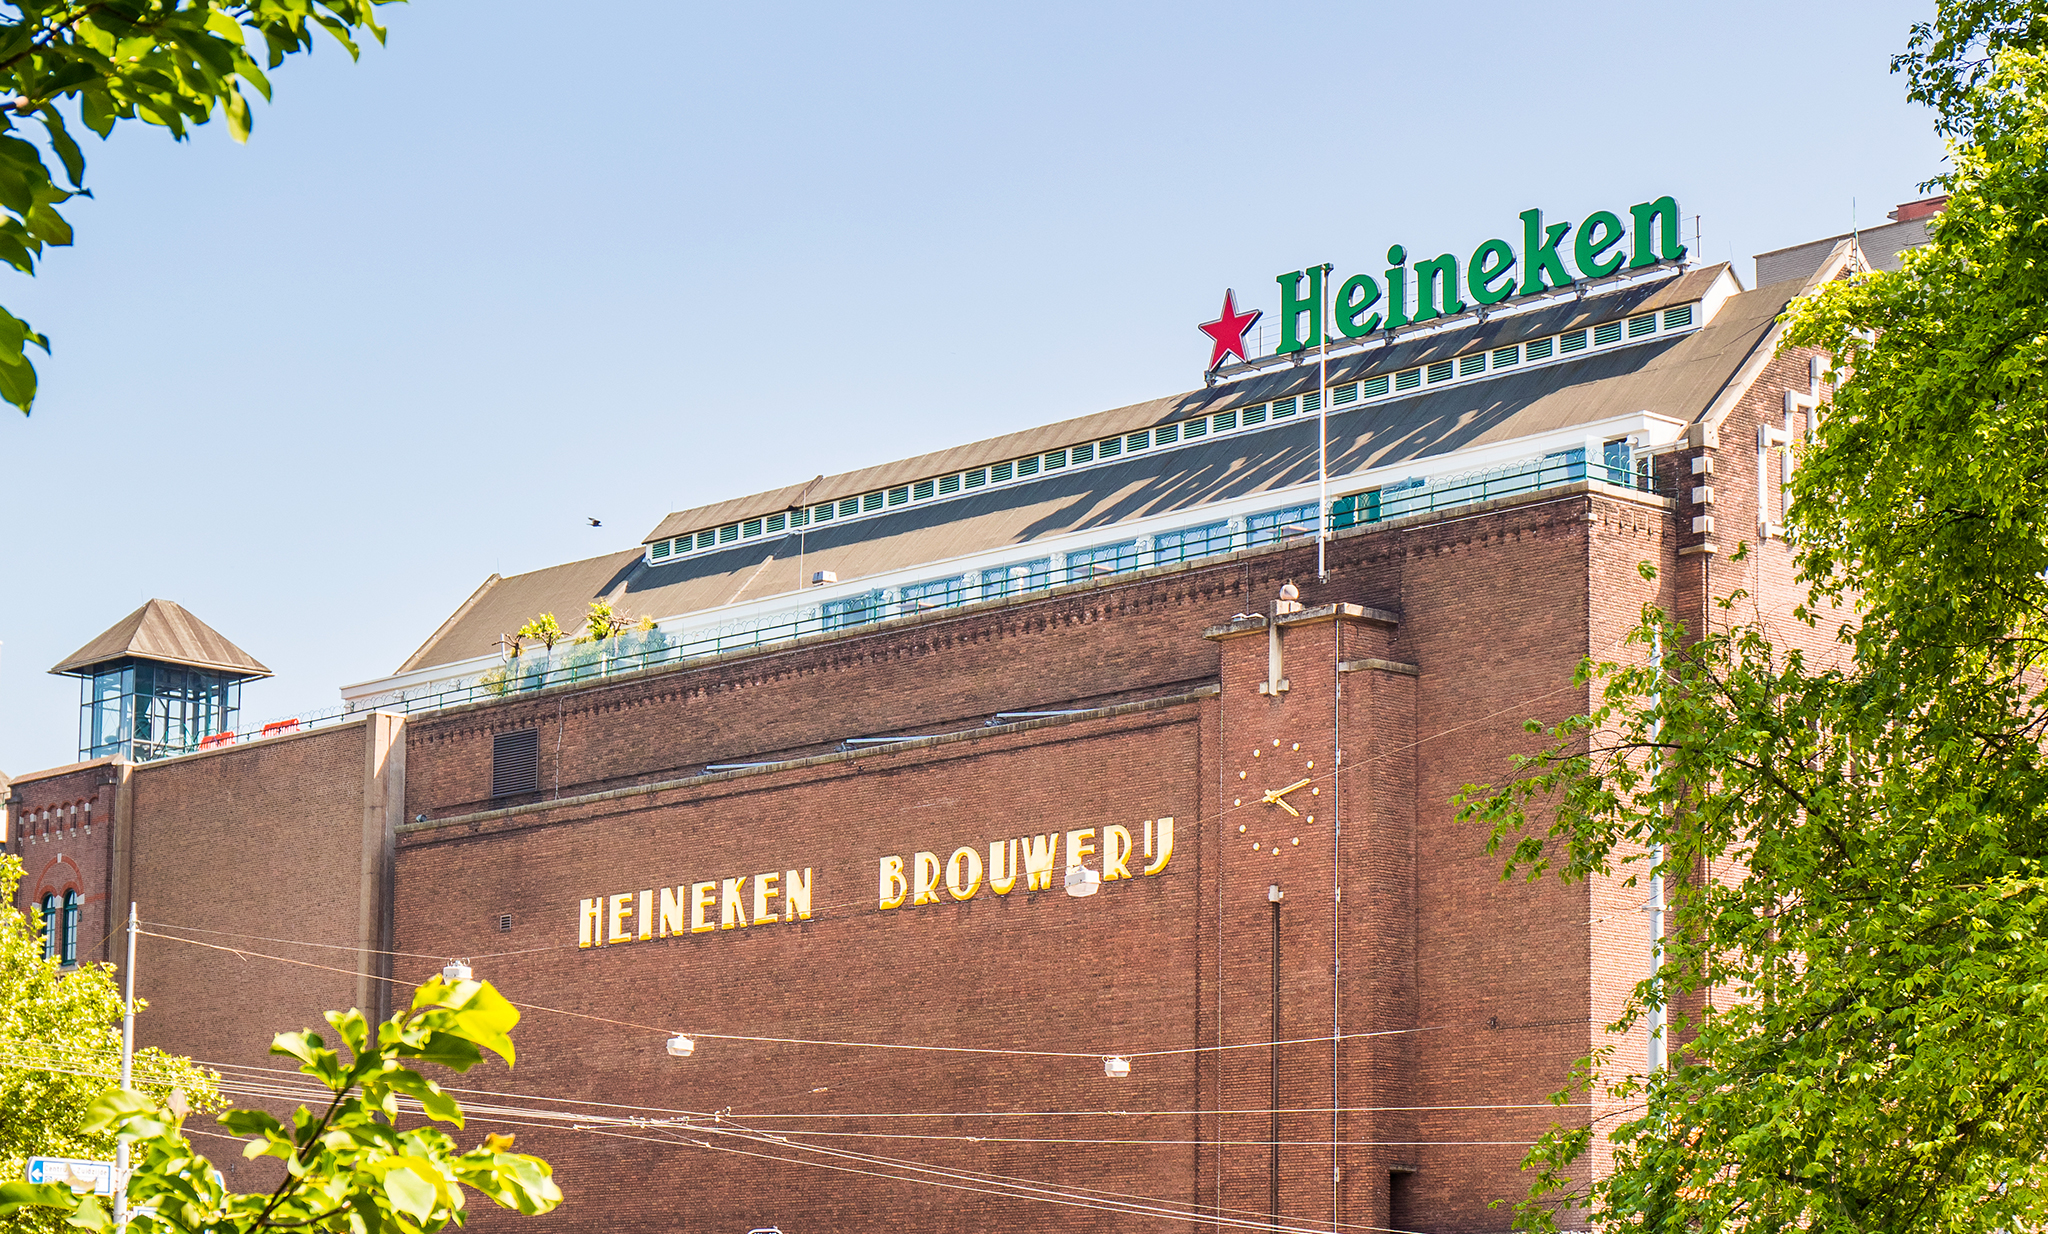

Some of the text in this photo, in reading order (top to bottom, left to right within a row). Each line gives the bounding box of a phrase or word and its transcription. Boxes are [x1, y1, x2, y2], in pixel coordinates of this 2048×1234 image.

[1276, 195, 1688, 356] Heineken
[578, 817, 1175, 949] HEINEKEN BROUWERIJ
